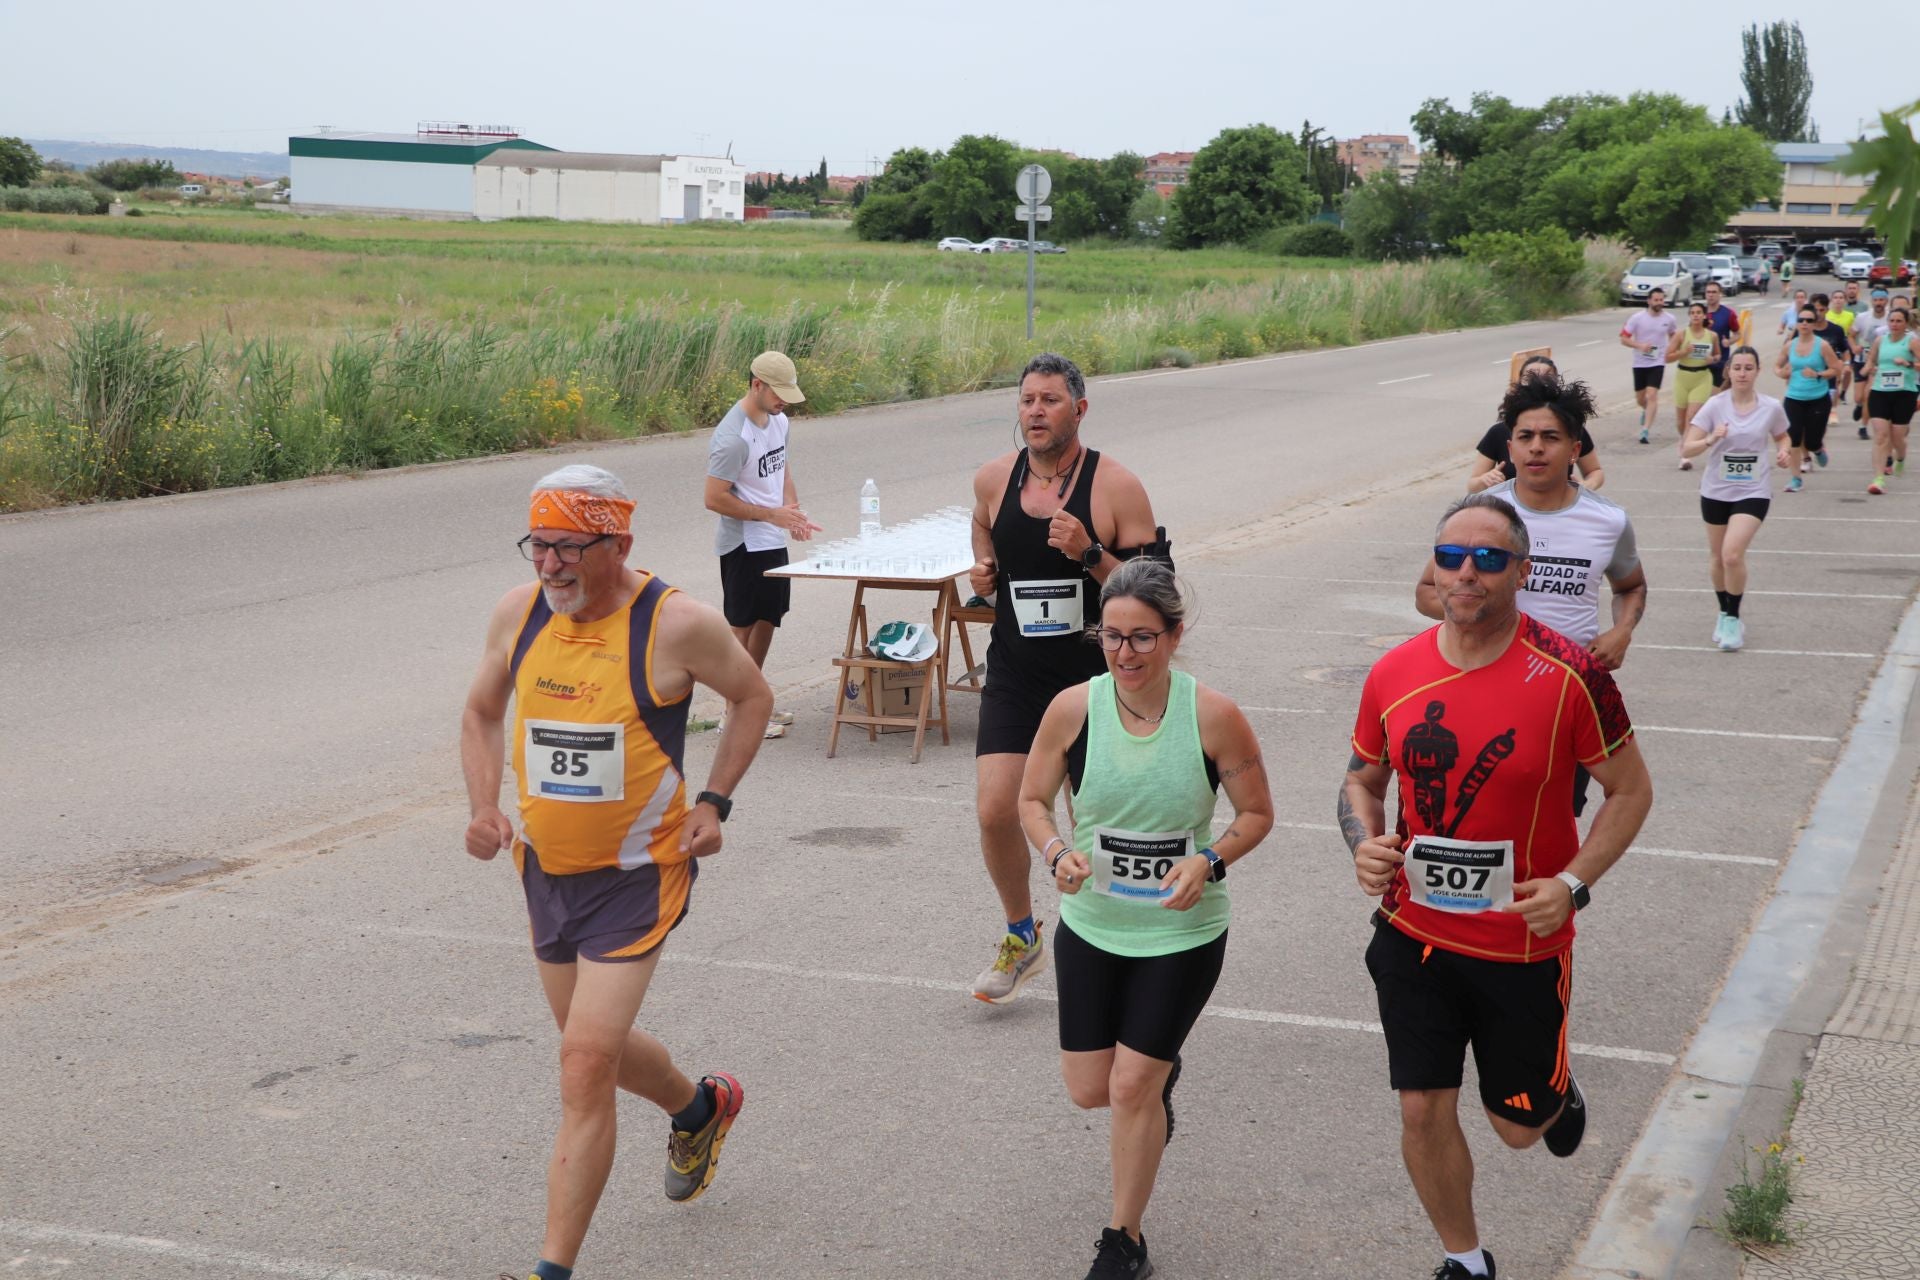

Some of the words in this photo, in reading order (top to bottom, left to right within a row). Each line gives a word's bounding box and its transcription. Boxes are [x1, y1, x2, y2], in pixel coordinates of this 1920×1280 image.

[1727, 463, 1753, 473] 504
[1529, 564, 1574, 579] IUDAD
[1040, 600, 1049, 619] 1
[536, 677, 576, 694] Inferno
[551, 750, 589, 777] 85
[1112, 855, 1174, 880] 550
[1426, 864, 1491, 891] 507
[1451, 891, 1484, 899] GABRIEL
